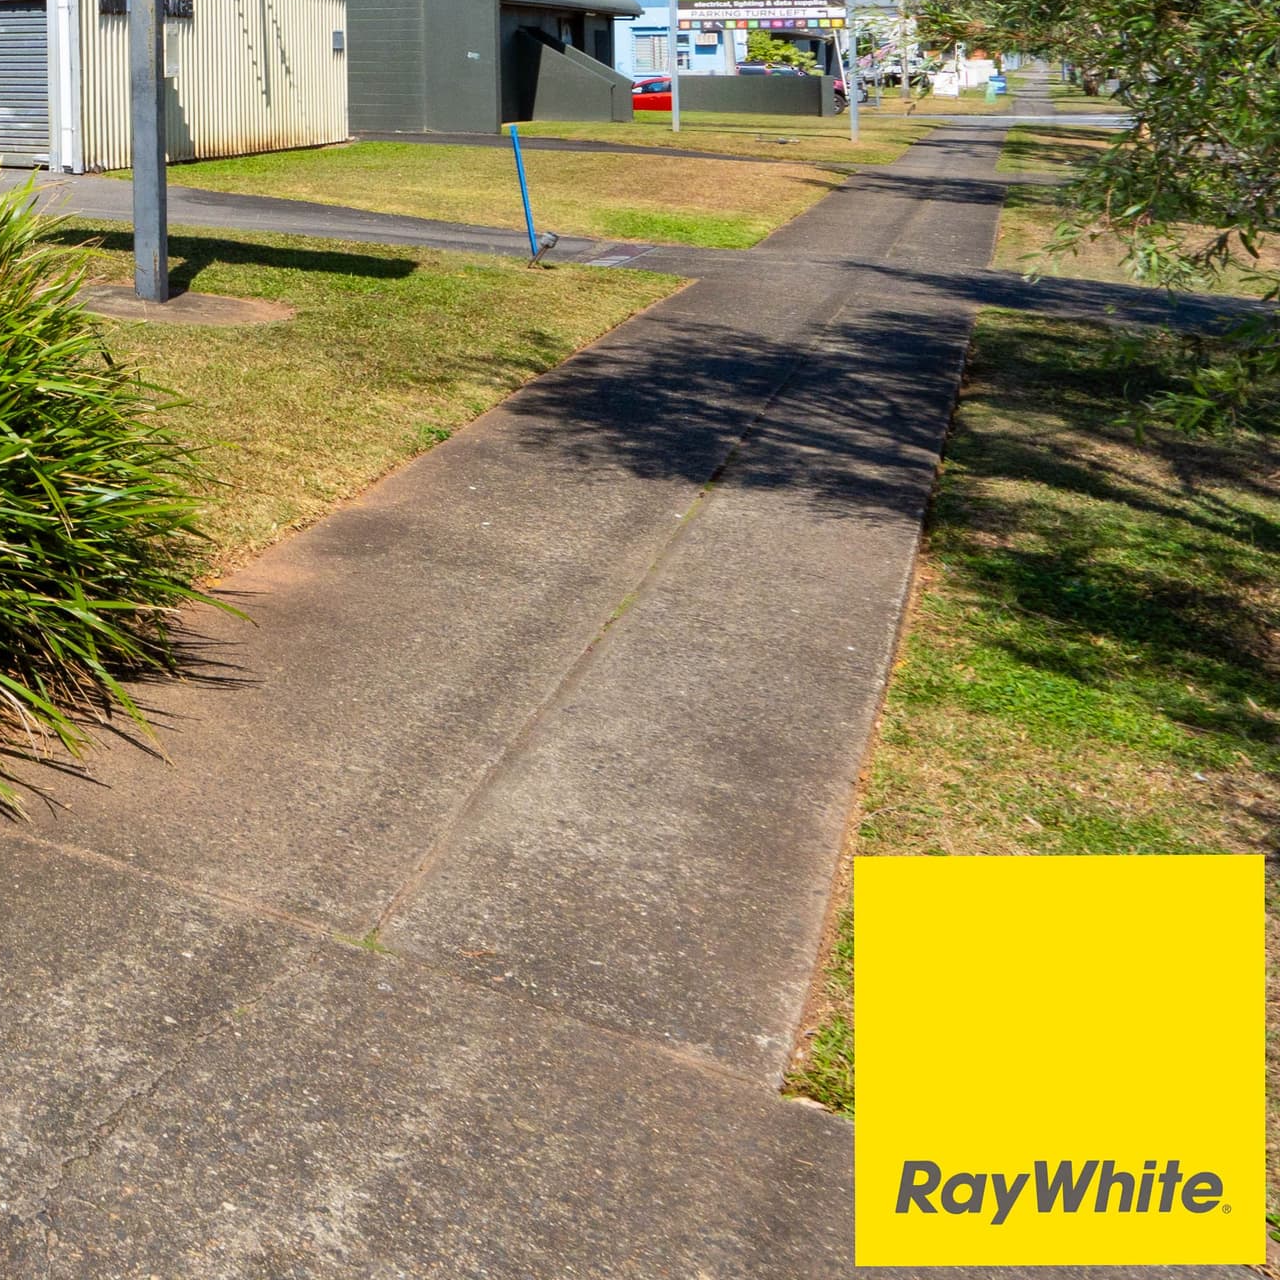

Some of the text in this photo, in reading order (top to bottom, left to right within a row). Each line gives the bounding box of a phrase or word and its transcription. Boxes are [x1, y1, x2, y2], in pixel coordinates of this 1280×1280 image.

[691, 8, 808, 17] PARKING TURN LEFT
